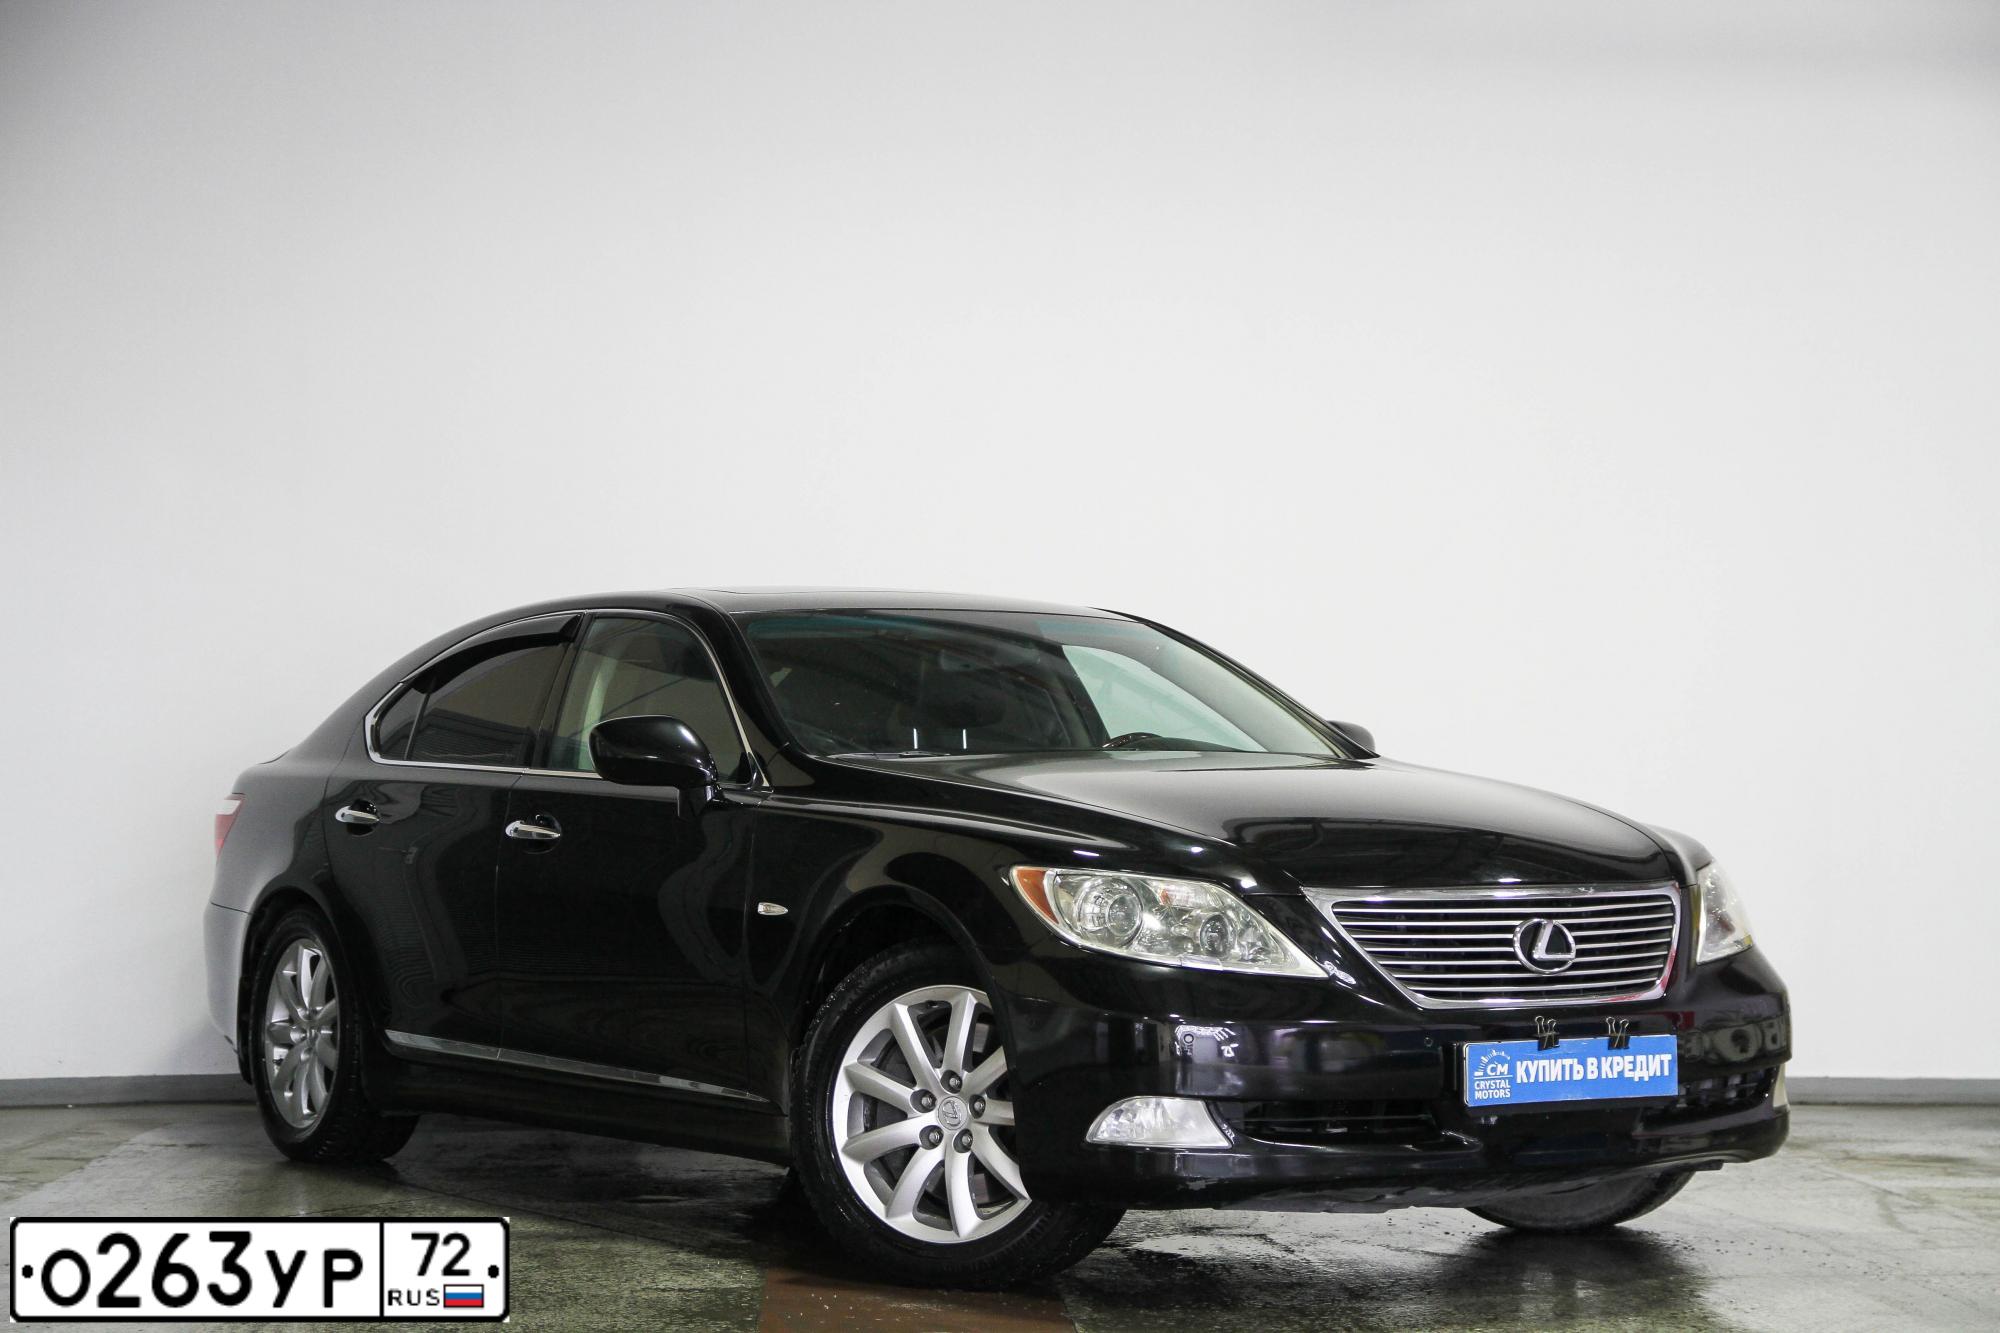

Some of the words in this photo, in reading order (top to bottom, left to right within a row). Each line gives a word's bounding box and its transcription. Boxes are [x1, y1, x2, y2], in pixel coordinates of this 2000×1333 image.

[1516, 1058, 1584, 1084] КУПИТЬ
[1601, 1053, 1672, 1081] КРЕДИТ
[1474, 1079, 1511, 1090] CRYSTAL
[1474, 1088, 1511, 1100] MOTORS
